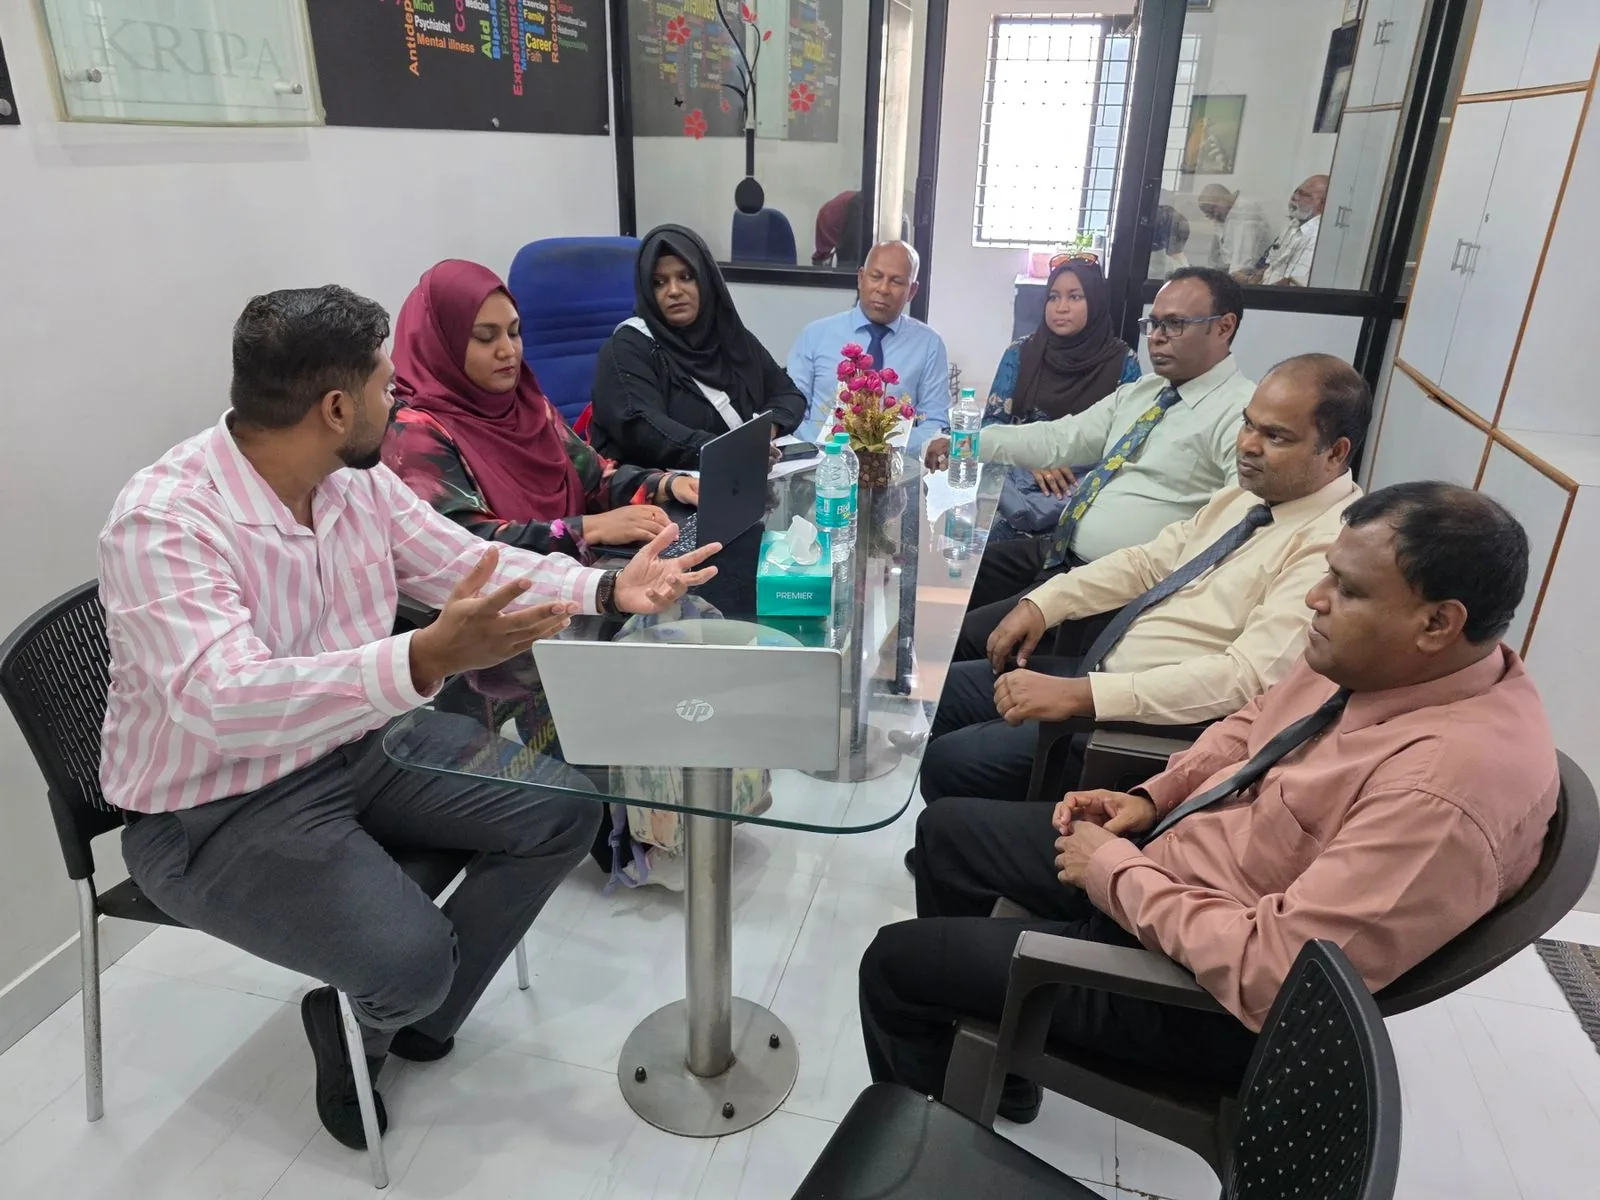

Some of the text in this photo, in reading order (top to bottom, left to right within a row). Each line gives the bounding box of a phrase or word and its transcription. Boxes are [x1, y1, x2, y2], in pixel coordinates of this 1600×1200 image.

[414, 14, 451, 34] Psychiatrist
[523, 8, 544, 24] Family
[86, 15, 290, 81] KRIPA
[416, 33, 447, 49] Mental
[479, 19, 493, 59] Aid
[525, 32, 552, 52] Career
[776, 591, 813, 600] PREMIER
[679, 699, 711, 722] hp
